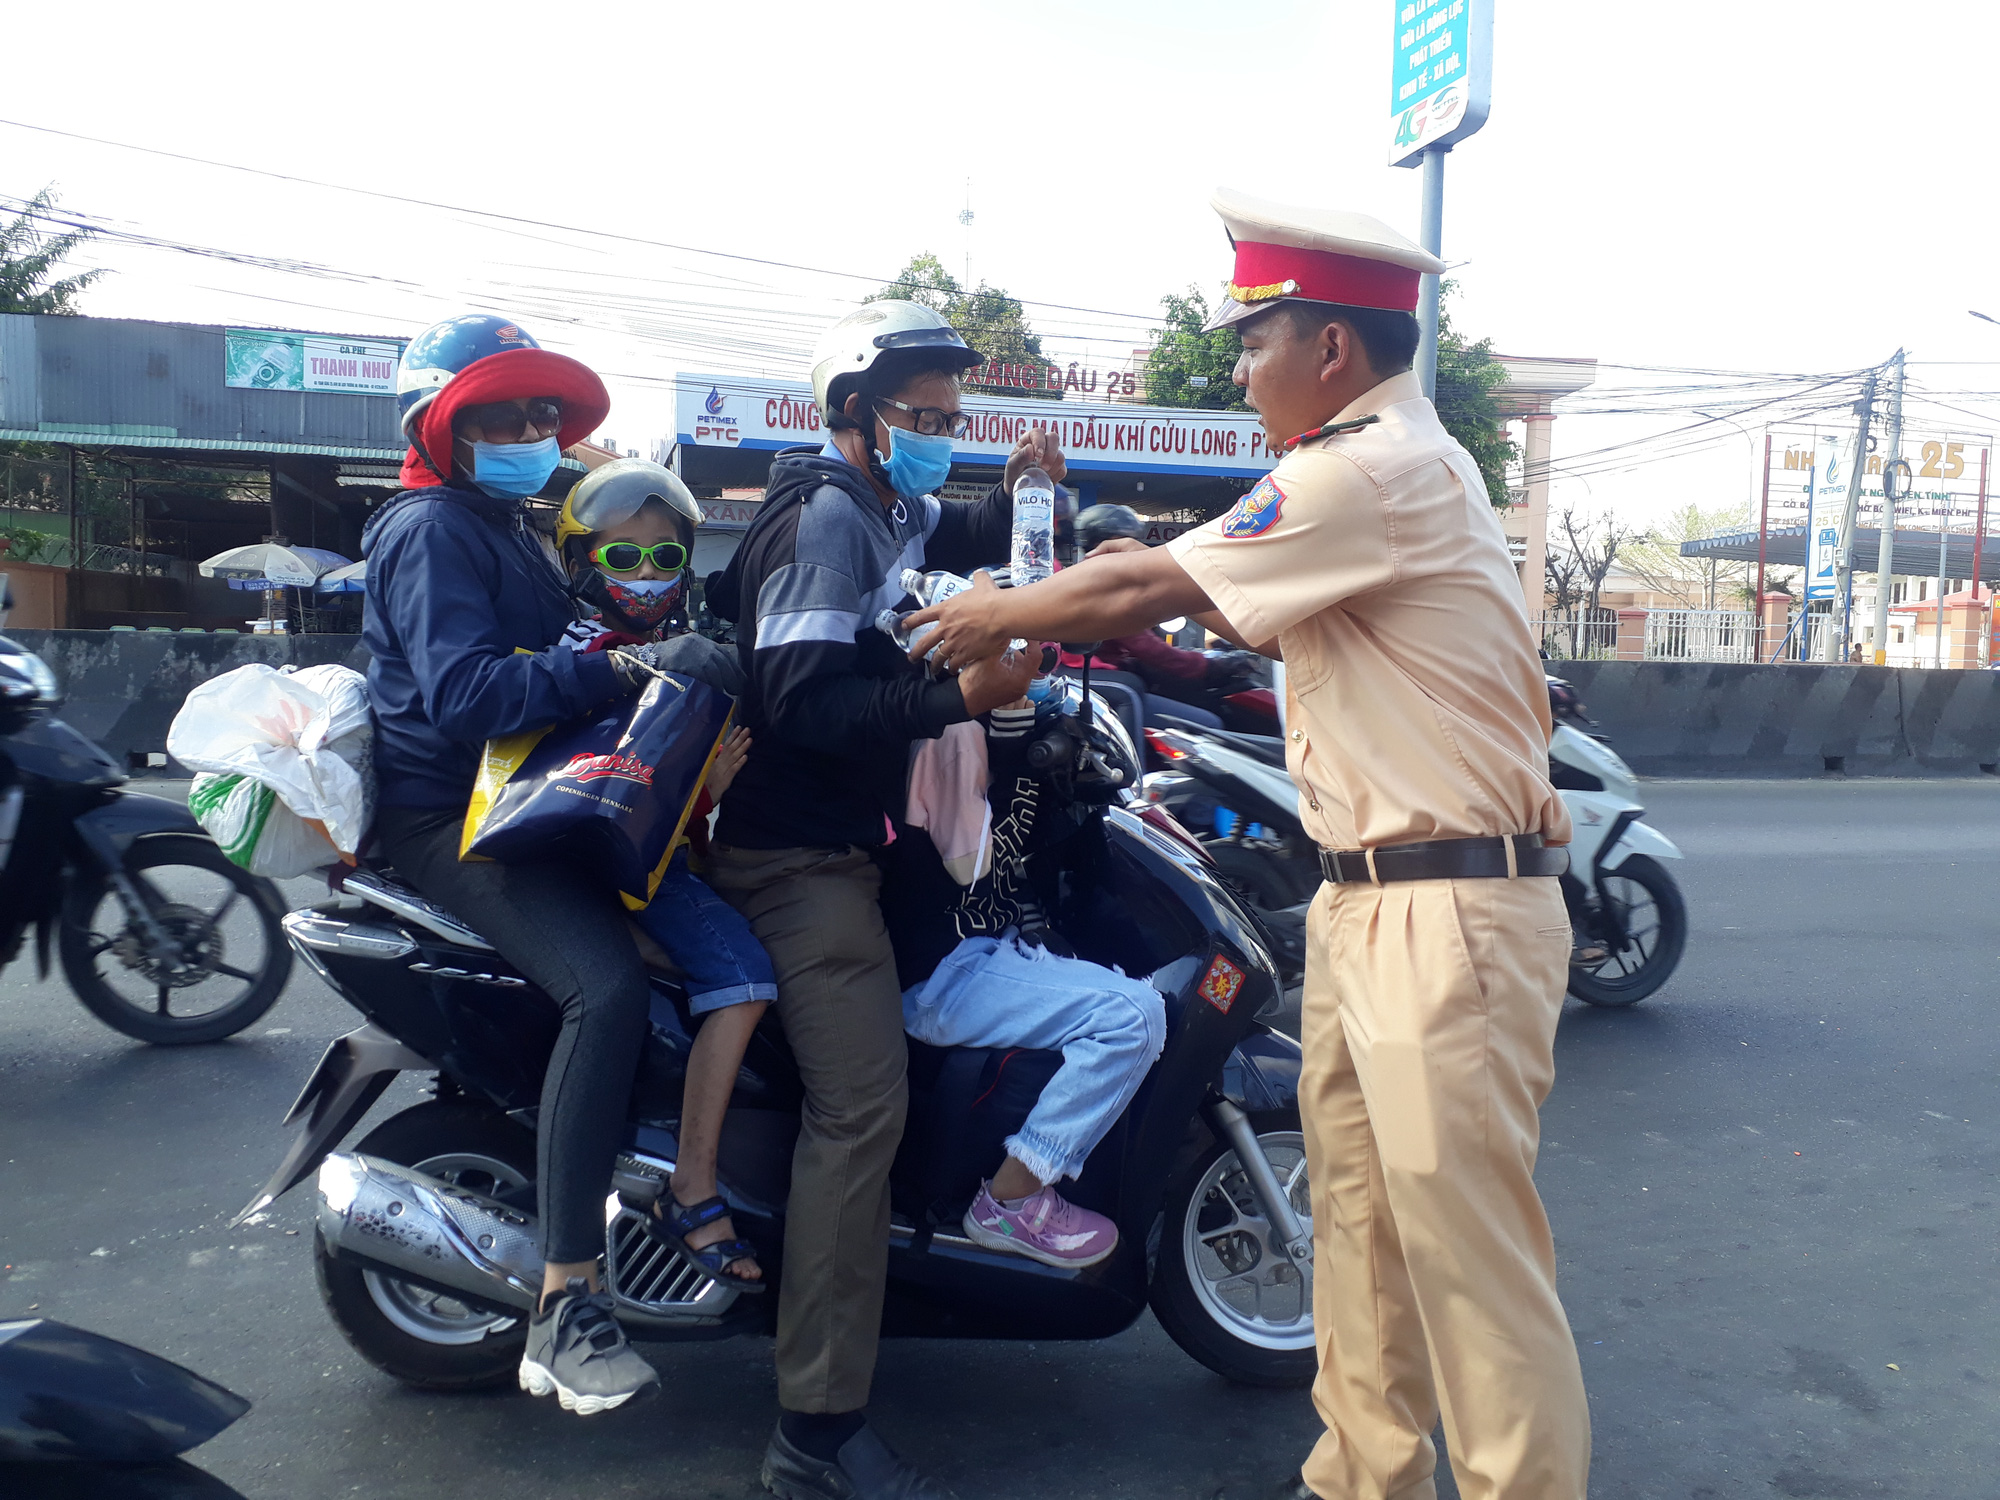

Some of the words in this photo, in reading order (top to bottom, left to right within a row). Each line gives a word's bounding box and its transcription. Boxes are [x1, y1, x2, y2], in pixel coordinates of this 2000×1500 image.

[1394, 99, 1428, 148] 4G
[310, 357, 357, 377] THANH
[362, 360, 393, 379] NHƯ
[1107, 371, 1136, 396] 25
[697, 415, 738, 425] PETIMEX
[765, 394, 820, 431] CÔNG
[695, 426, 739, 441] PTC
[1072, 414, 1109, 450] DẦU
[1114, 420, 1146, 451] KHÍ
[1150, 418, 1186, 453] CỬU
[1190, 428, 1237, 456] LONG
[1919, 440, 1965, 479] 25
[1815, 516, 1829, 527] 25
[565, 751, 655, 783] Danisa
[555, 784, 600, 801] COPENHAGEN
[601, 797, 634, 814] DENMARK
